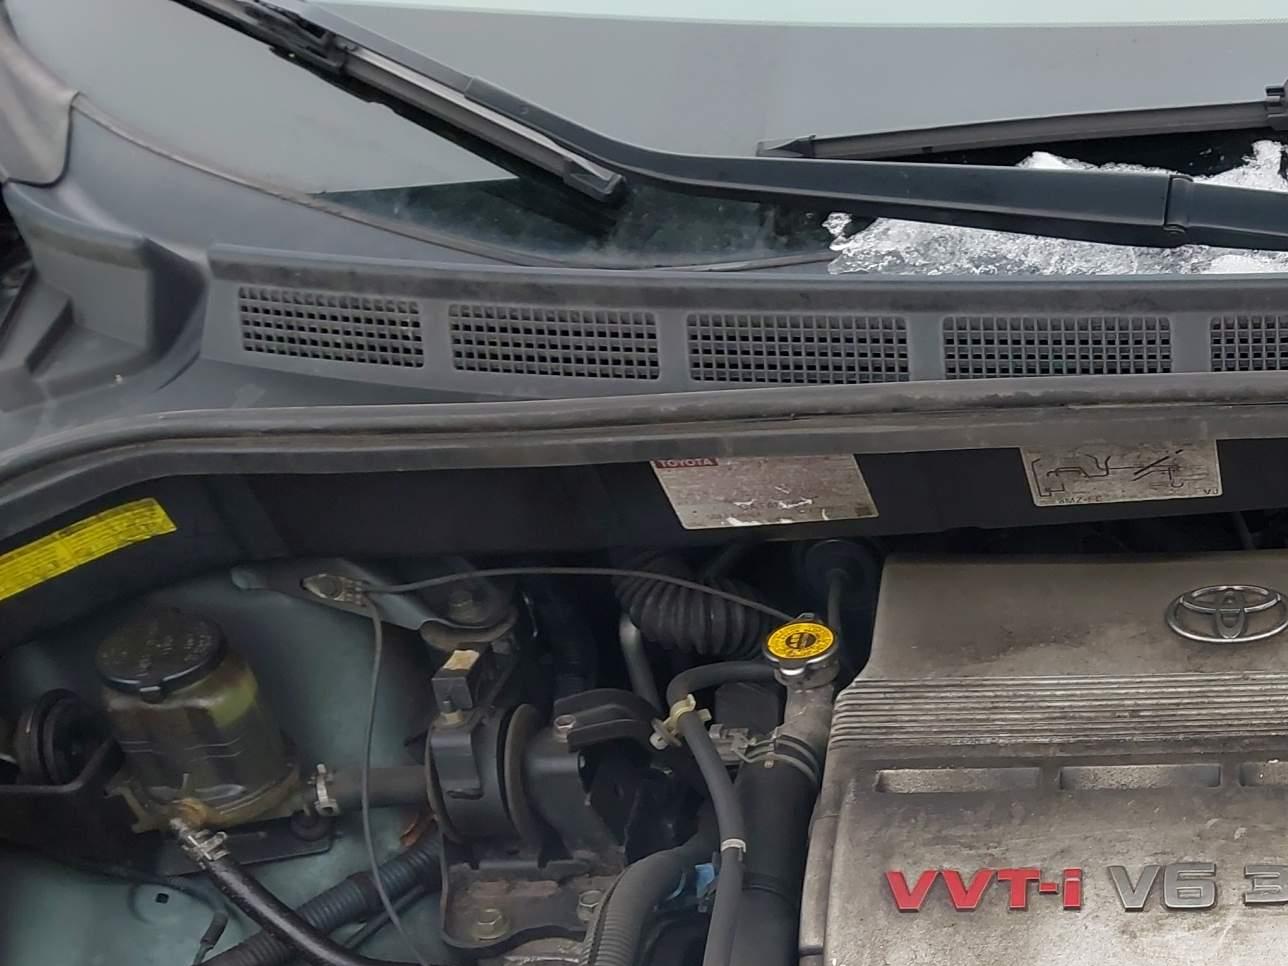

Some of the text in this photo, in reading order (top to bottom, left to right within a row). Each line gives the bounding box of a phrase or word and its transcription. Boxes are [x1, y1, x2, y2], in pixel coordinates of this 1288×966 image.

[659, 458, 713, 468] TOYOTA
[885, 868, 1084, 913] VVT-i
[1107, 863, 1218, 912] V6
